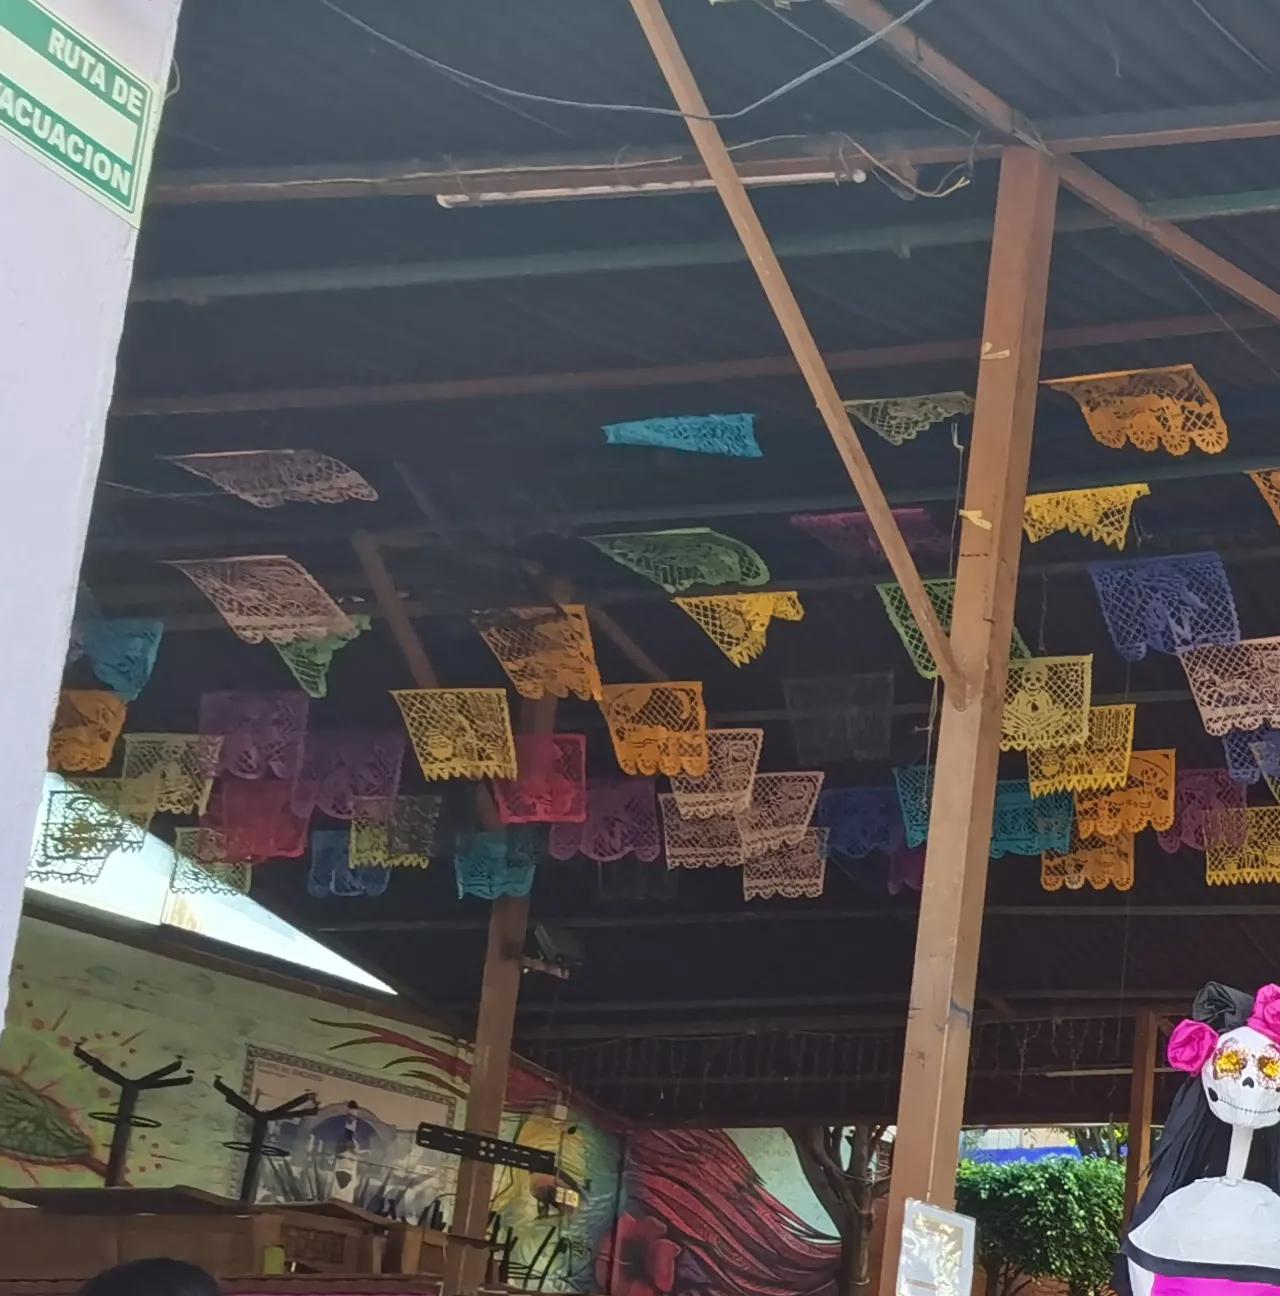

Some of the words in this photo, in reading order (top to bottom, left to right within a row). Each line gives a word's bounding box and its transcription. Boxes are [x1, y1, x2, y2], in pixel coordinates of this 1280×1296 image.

[48, 28, 107, 93] RUTA
[111, 75, 144, 118] DE
[0, 82, 131, 196] ACUACION
